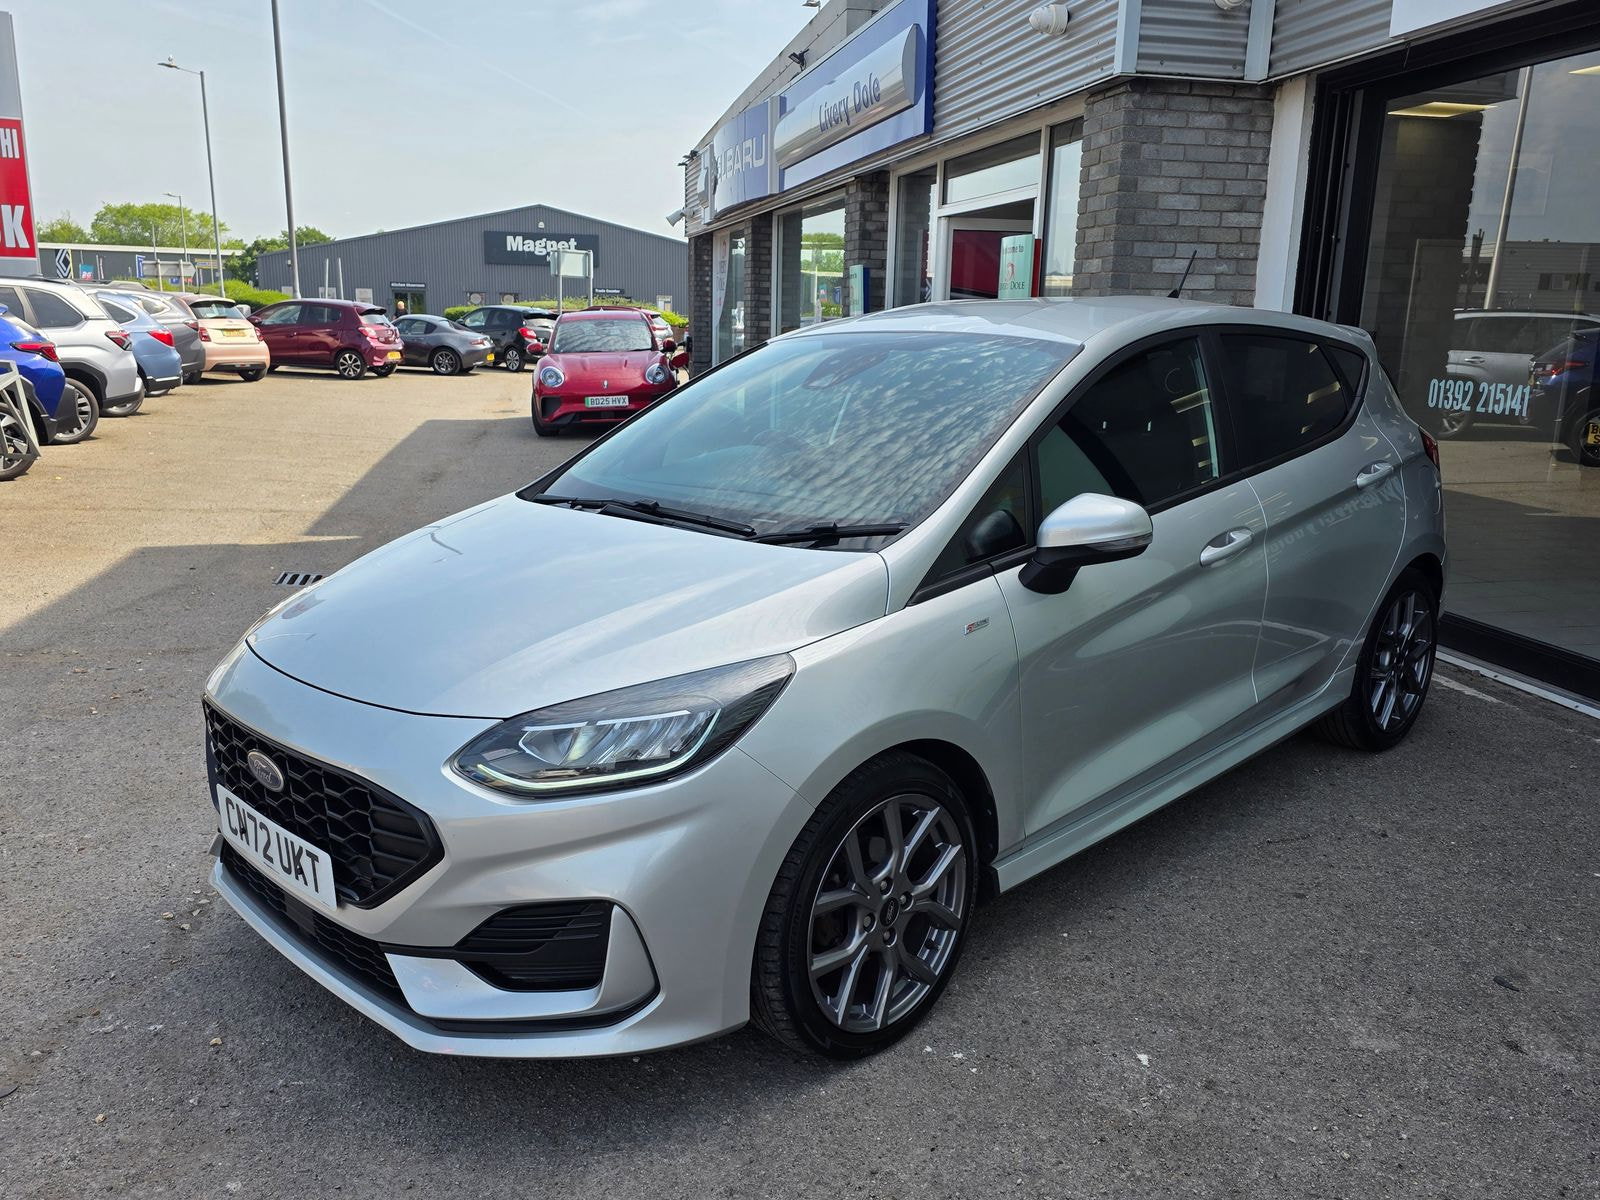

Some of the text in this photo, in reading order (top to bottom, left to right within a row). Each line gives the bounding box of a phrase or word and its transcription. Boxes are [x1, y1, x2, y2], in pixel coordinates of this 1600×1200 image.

[819, 72, 881, 132] Livery Dole
[506, 235, 577, 256] Magnet
[590, 396, 627, 406] BD25 HVX
[1428, 379, 1530, 417] 01392 215141
[275, 830, 320, 894] UKT
